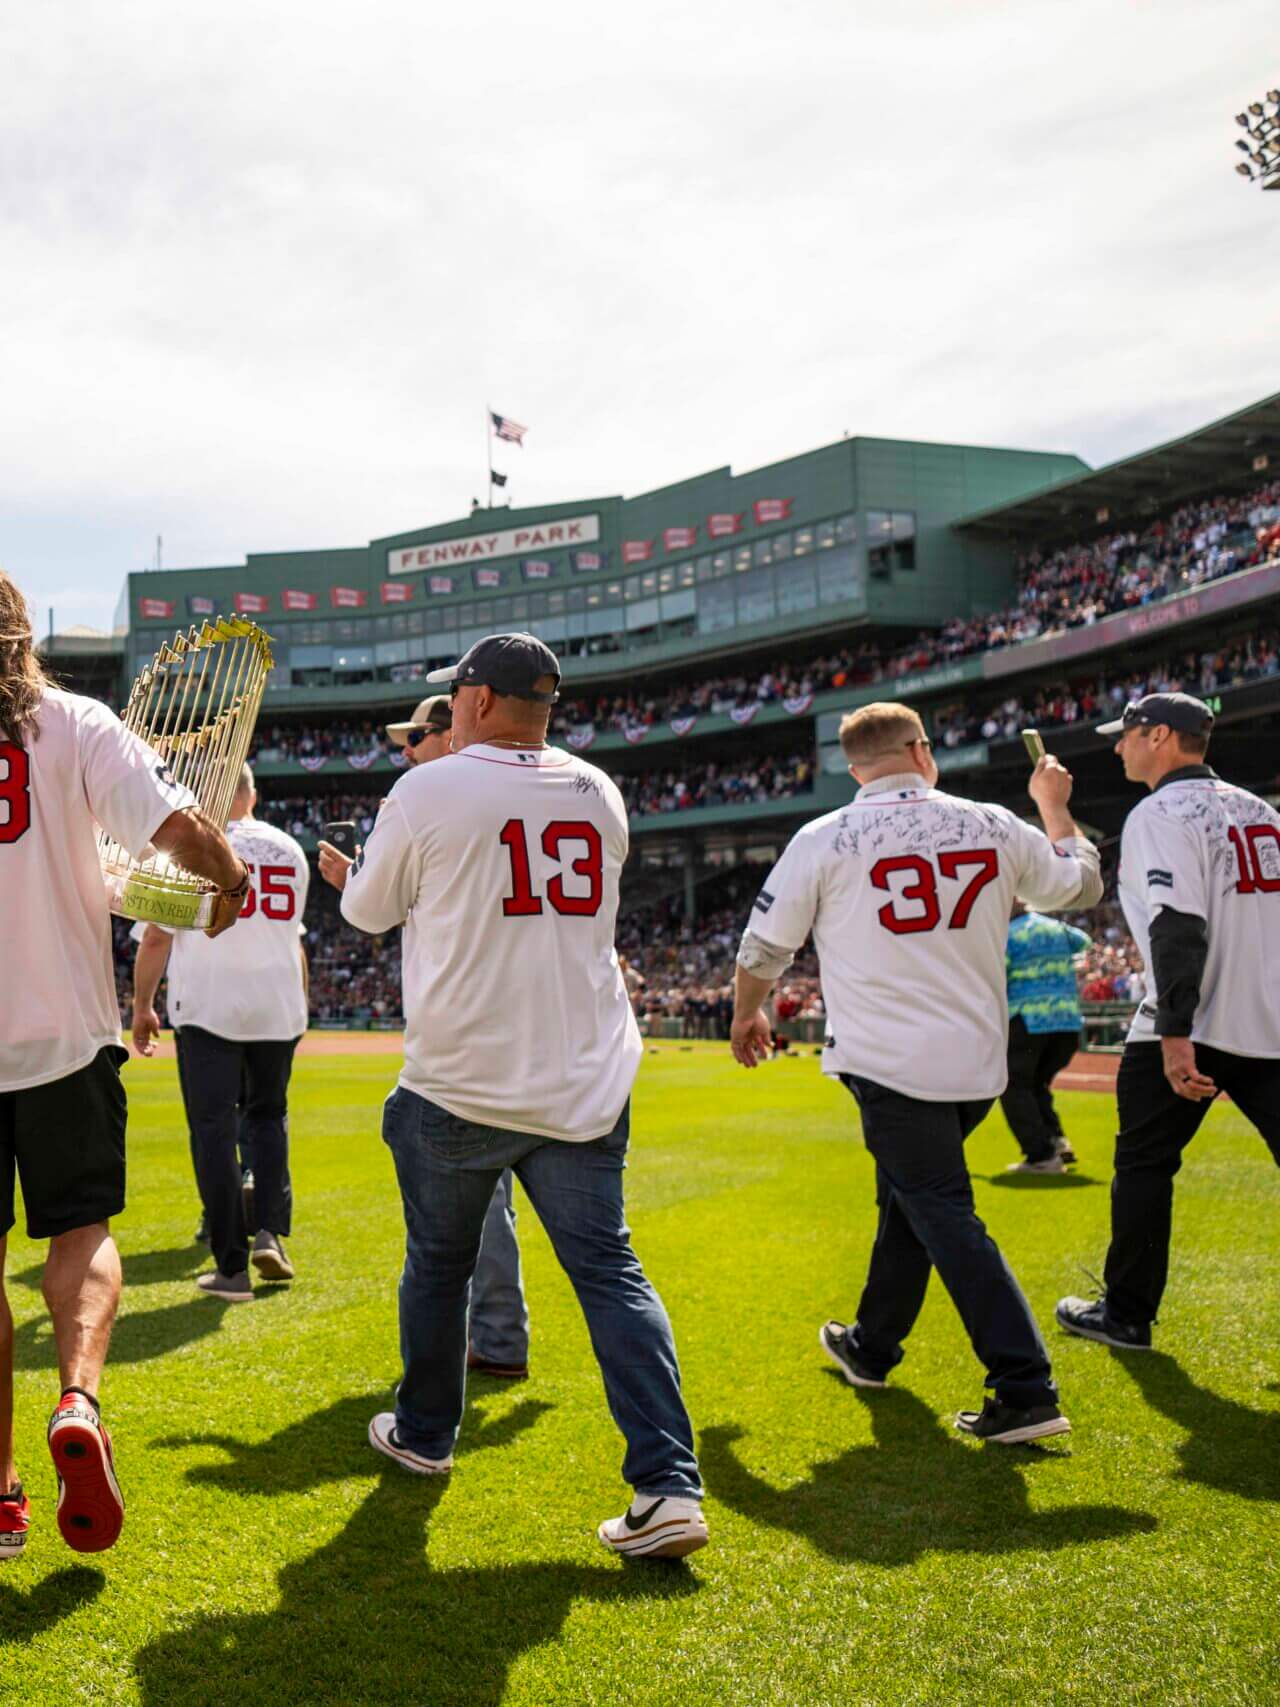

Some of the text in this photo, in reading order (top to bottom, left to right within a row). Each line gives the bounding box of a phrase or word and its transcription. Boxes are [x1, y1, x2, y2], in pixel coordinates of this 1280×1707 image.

[400, 536, 499, 569] FENWAY
[513, 523, 583, 548] PARK
[500, 818, 603, 917] 13
[869, 848, 999, 935] 37
[1227, 823, 1280, 895] 10
